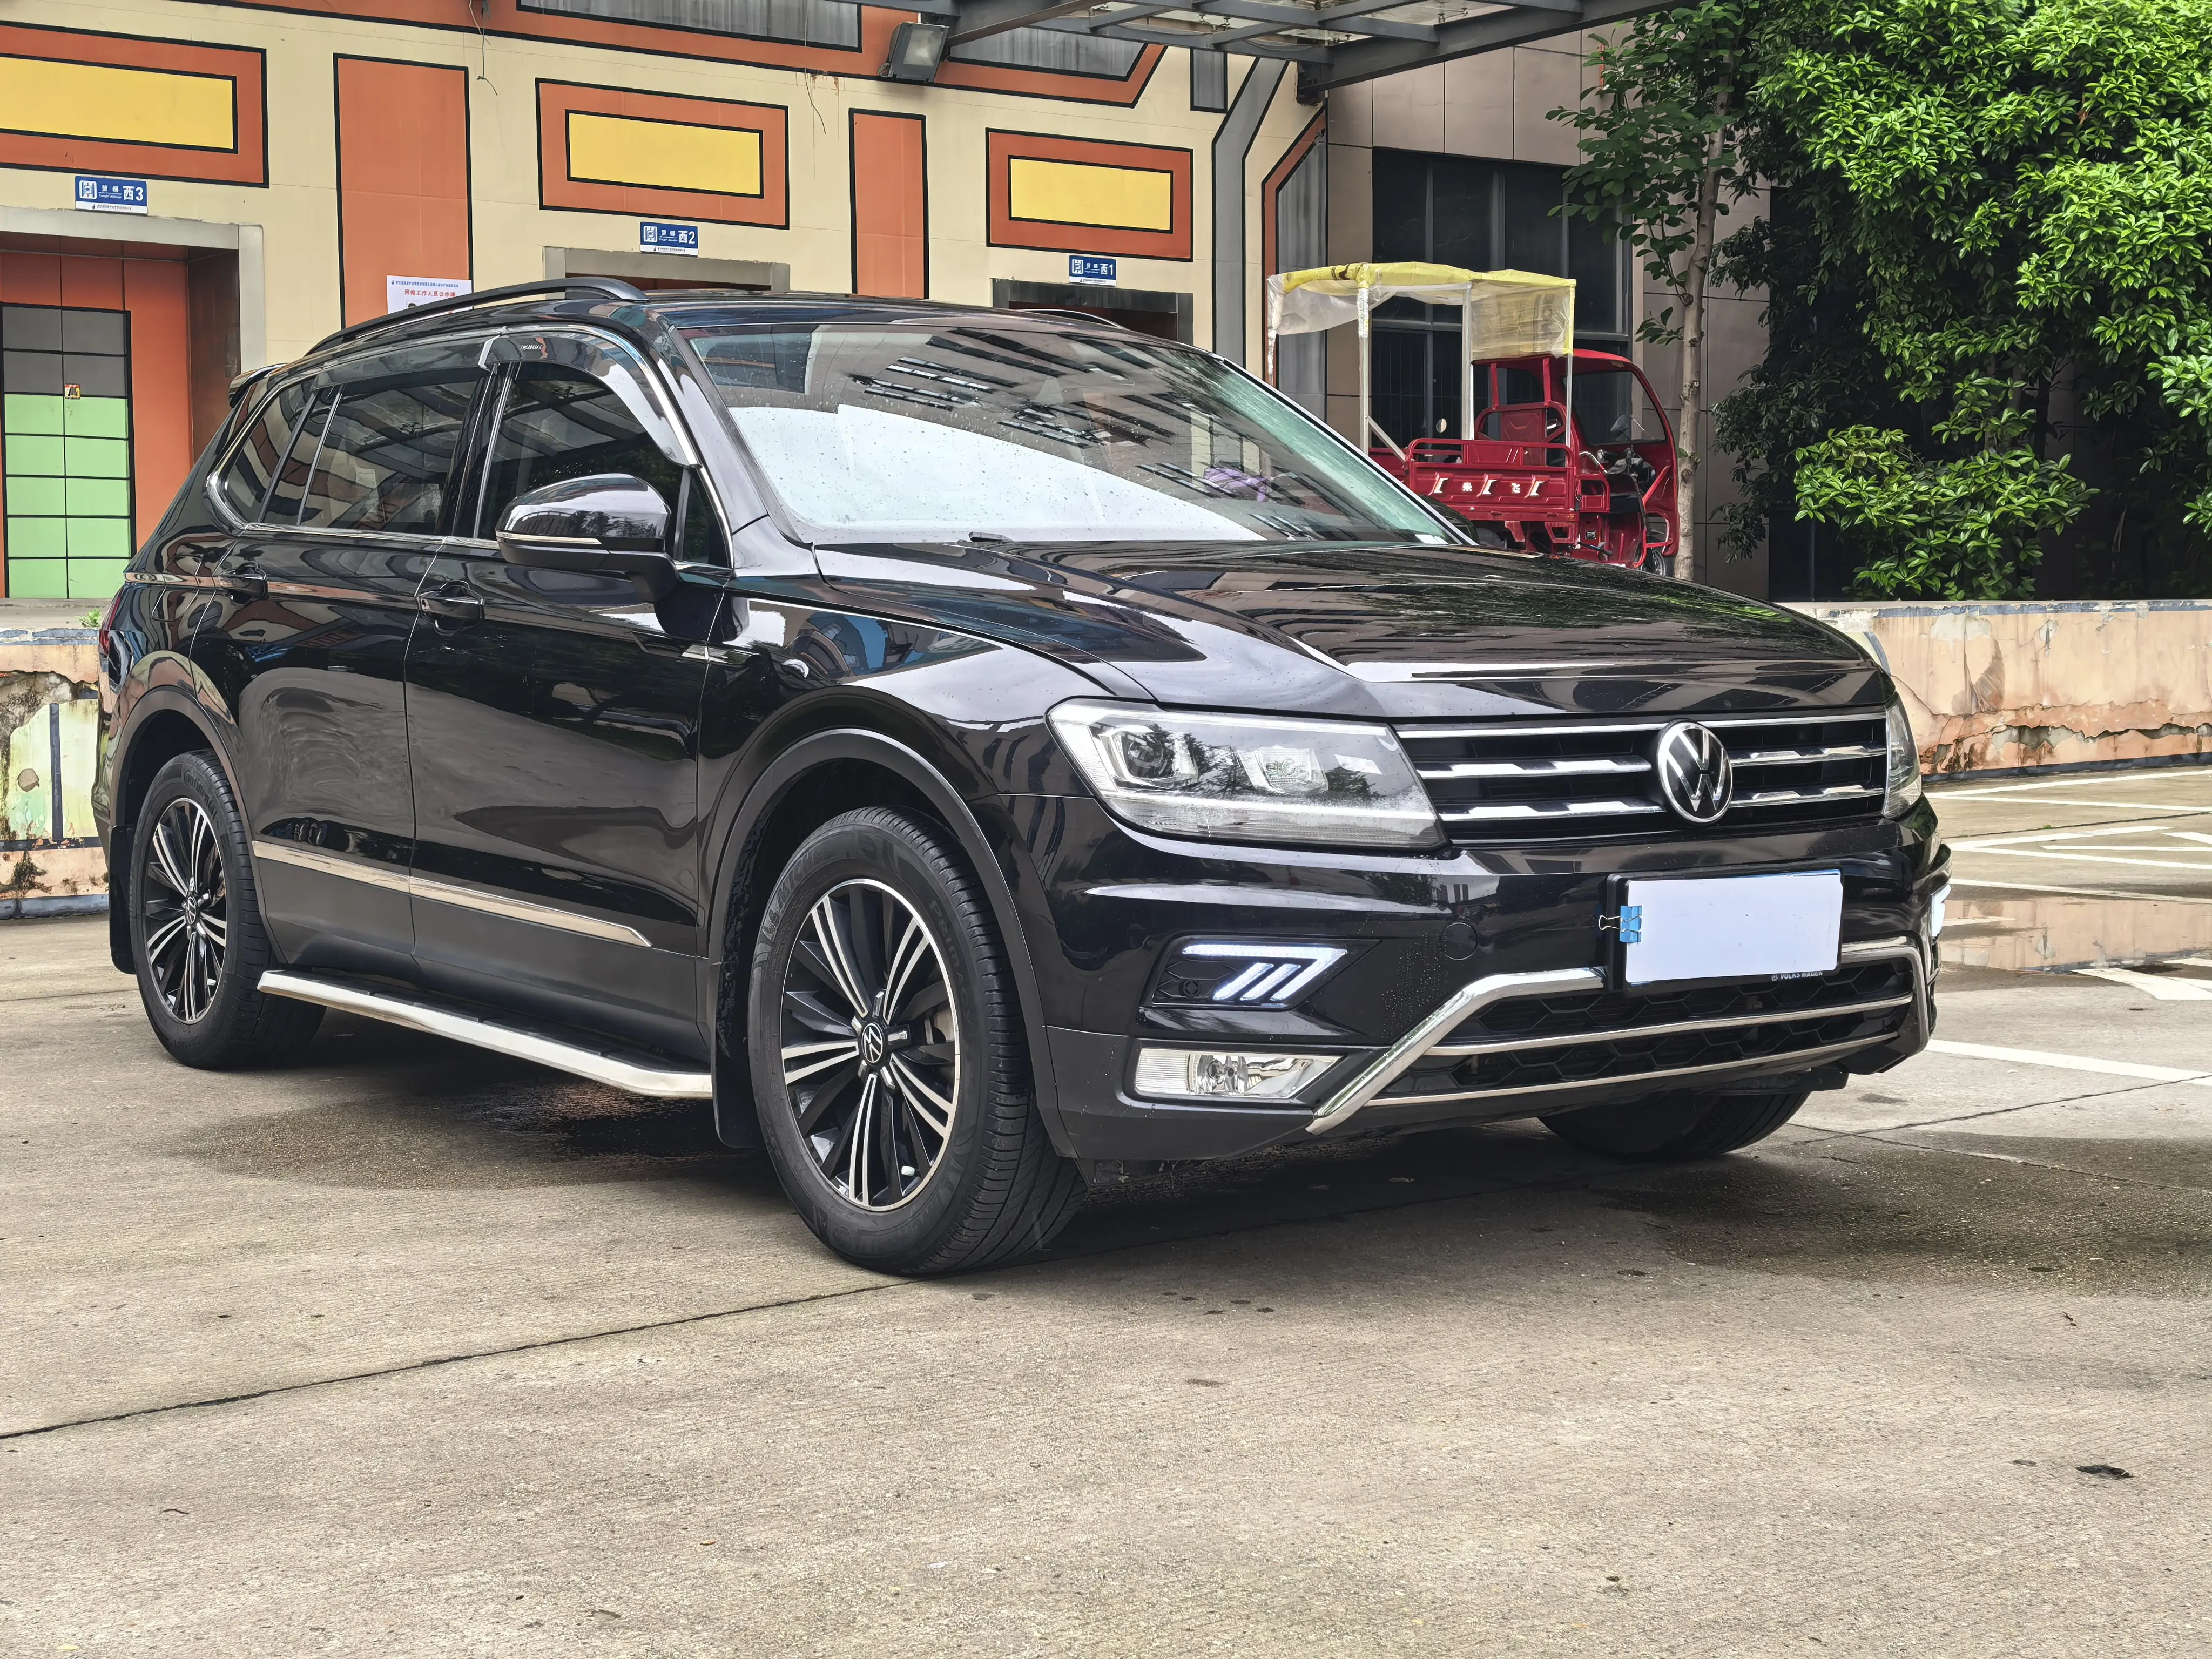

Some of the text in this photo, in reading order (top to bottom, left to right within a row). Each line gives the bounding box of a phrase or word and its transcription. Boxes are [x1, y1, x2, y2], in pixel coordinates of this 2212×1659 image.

[123, 185, 143, 201] 西3
[678, 230, 696, 244] 西2
[1100, 264, 1114, 275] 西1
